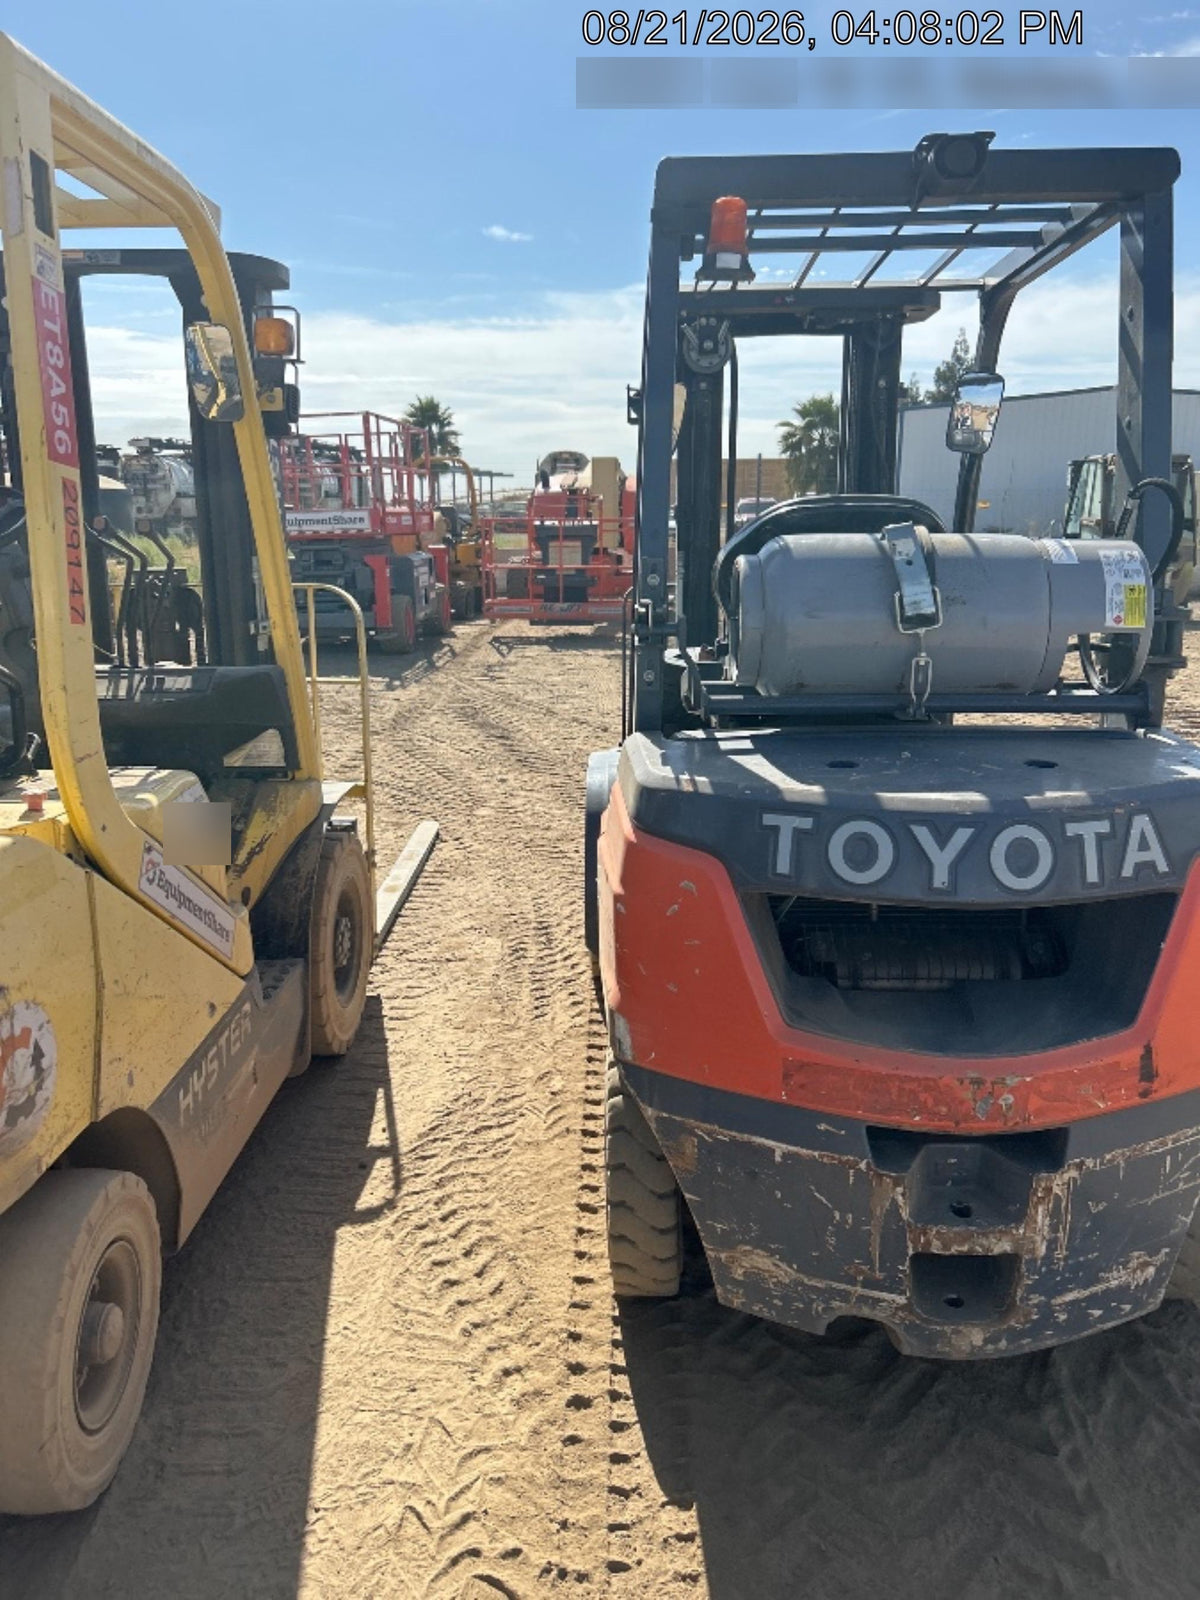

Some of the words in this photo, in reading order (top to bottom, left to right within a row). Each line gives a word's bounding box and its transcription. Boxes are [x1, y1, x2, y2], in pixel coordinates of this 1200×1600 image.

[39, 286, 72, 456] ET8A56
[287, 514, 365, 528] uipmentShare
[761, 812, 1171, 891] TOYOTA
[156, 867, 231, 943] EquipmentShare
[178, 1001, 252, 1128] HYSTER
